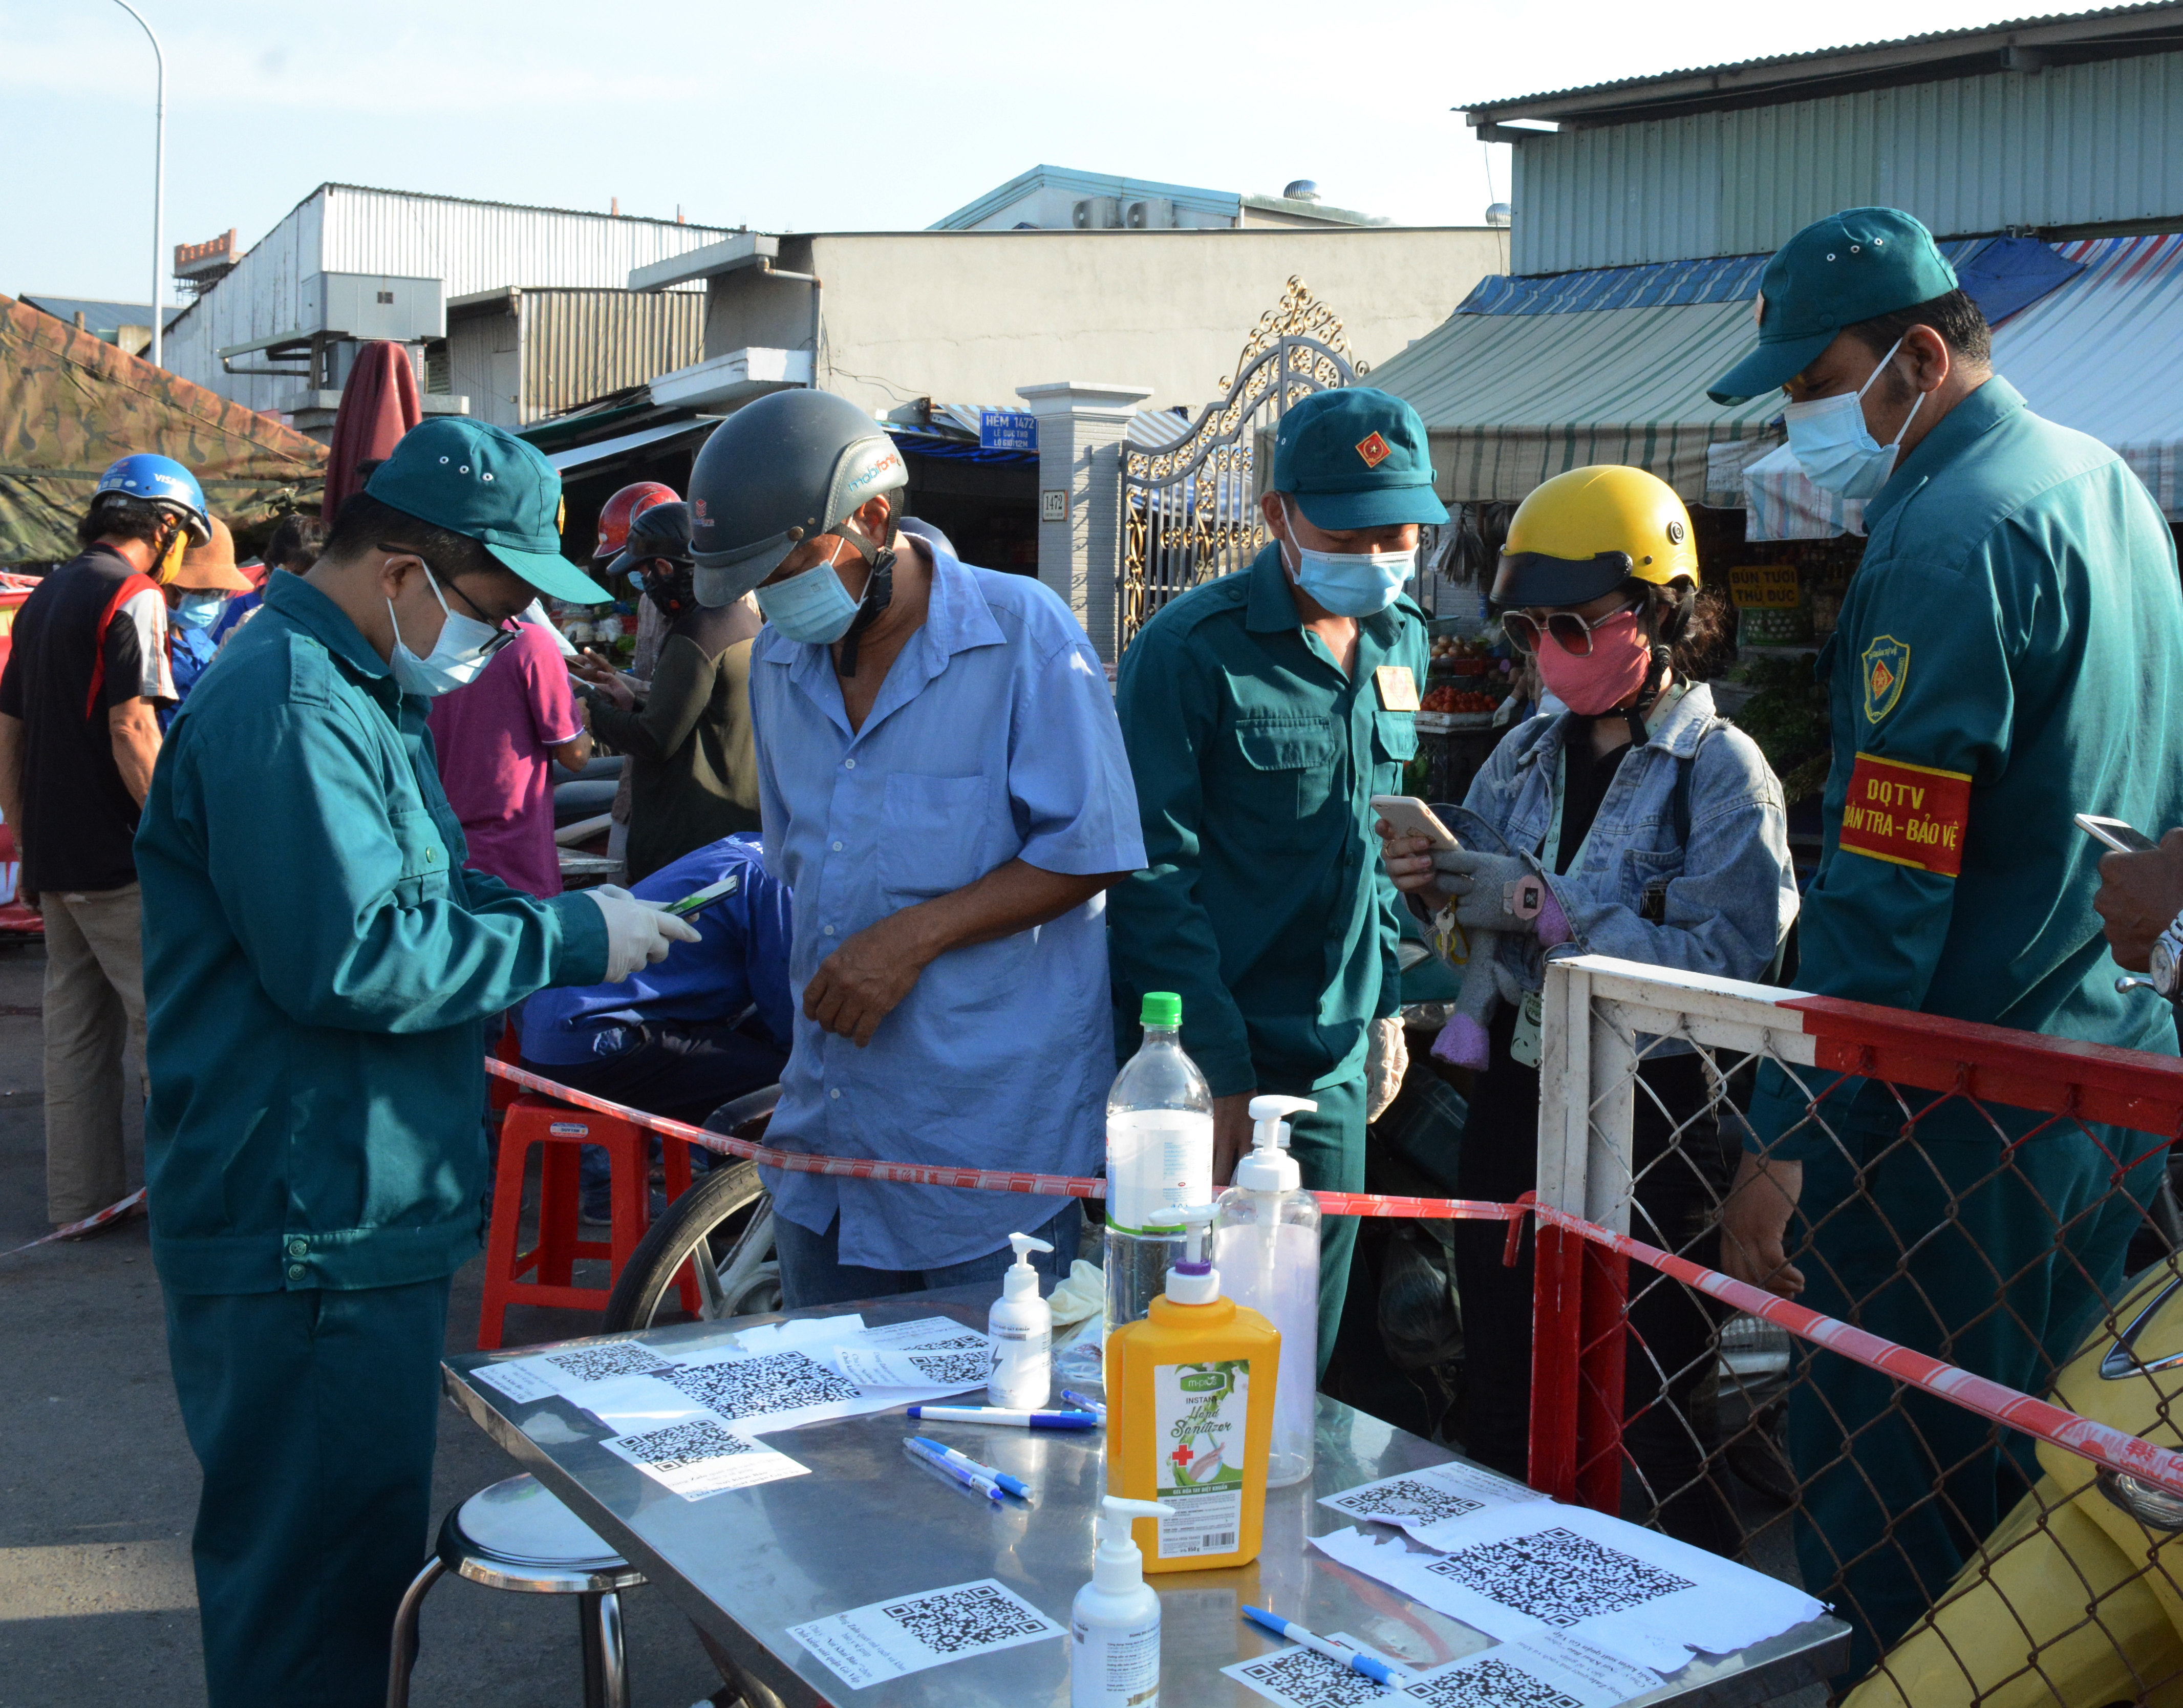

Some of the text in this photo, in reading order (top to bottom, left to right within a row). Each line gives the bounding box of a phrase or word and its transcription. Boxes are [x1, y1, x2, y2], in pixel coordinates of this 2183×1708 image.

[1014, 417, 1034, 429] 1472
[154, 473, 178, 485] VISA
[849, 453, 896, 492] mobifone
[1045, 495, 1062, 510] 1472
[1732, 568, 1760, 583] BÚN
[1736, 585, 1763, 601] THỦ
[1867, 779, 1924, 809] DQTV
[1866, 810, 1892, 837] TRA
[1906, 814, 1939, 844] BẢO
[1943, 820, 1959, 850] VỆ
[1186, 1396, 1217, 1404] INSTANT
[1185, 1405, 1219, 1421] Hand
[1170, 1419, 1232, 1438] Sanitizer
